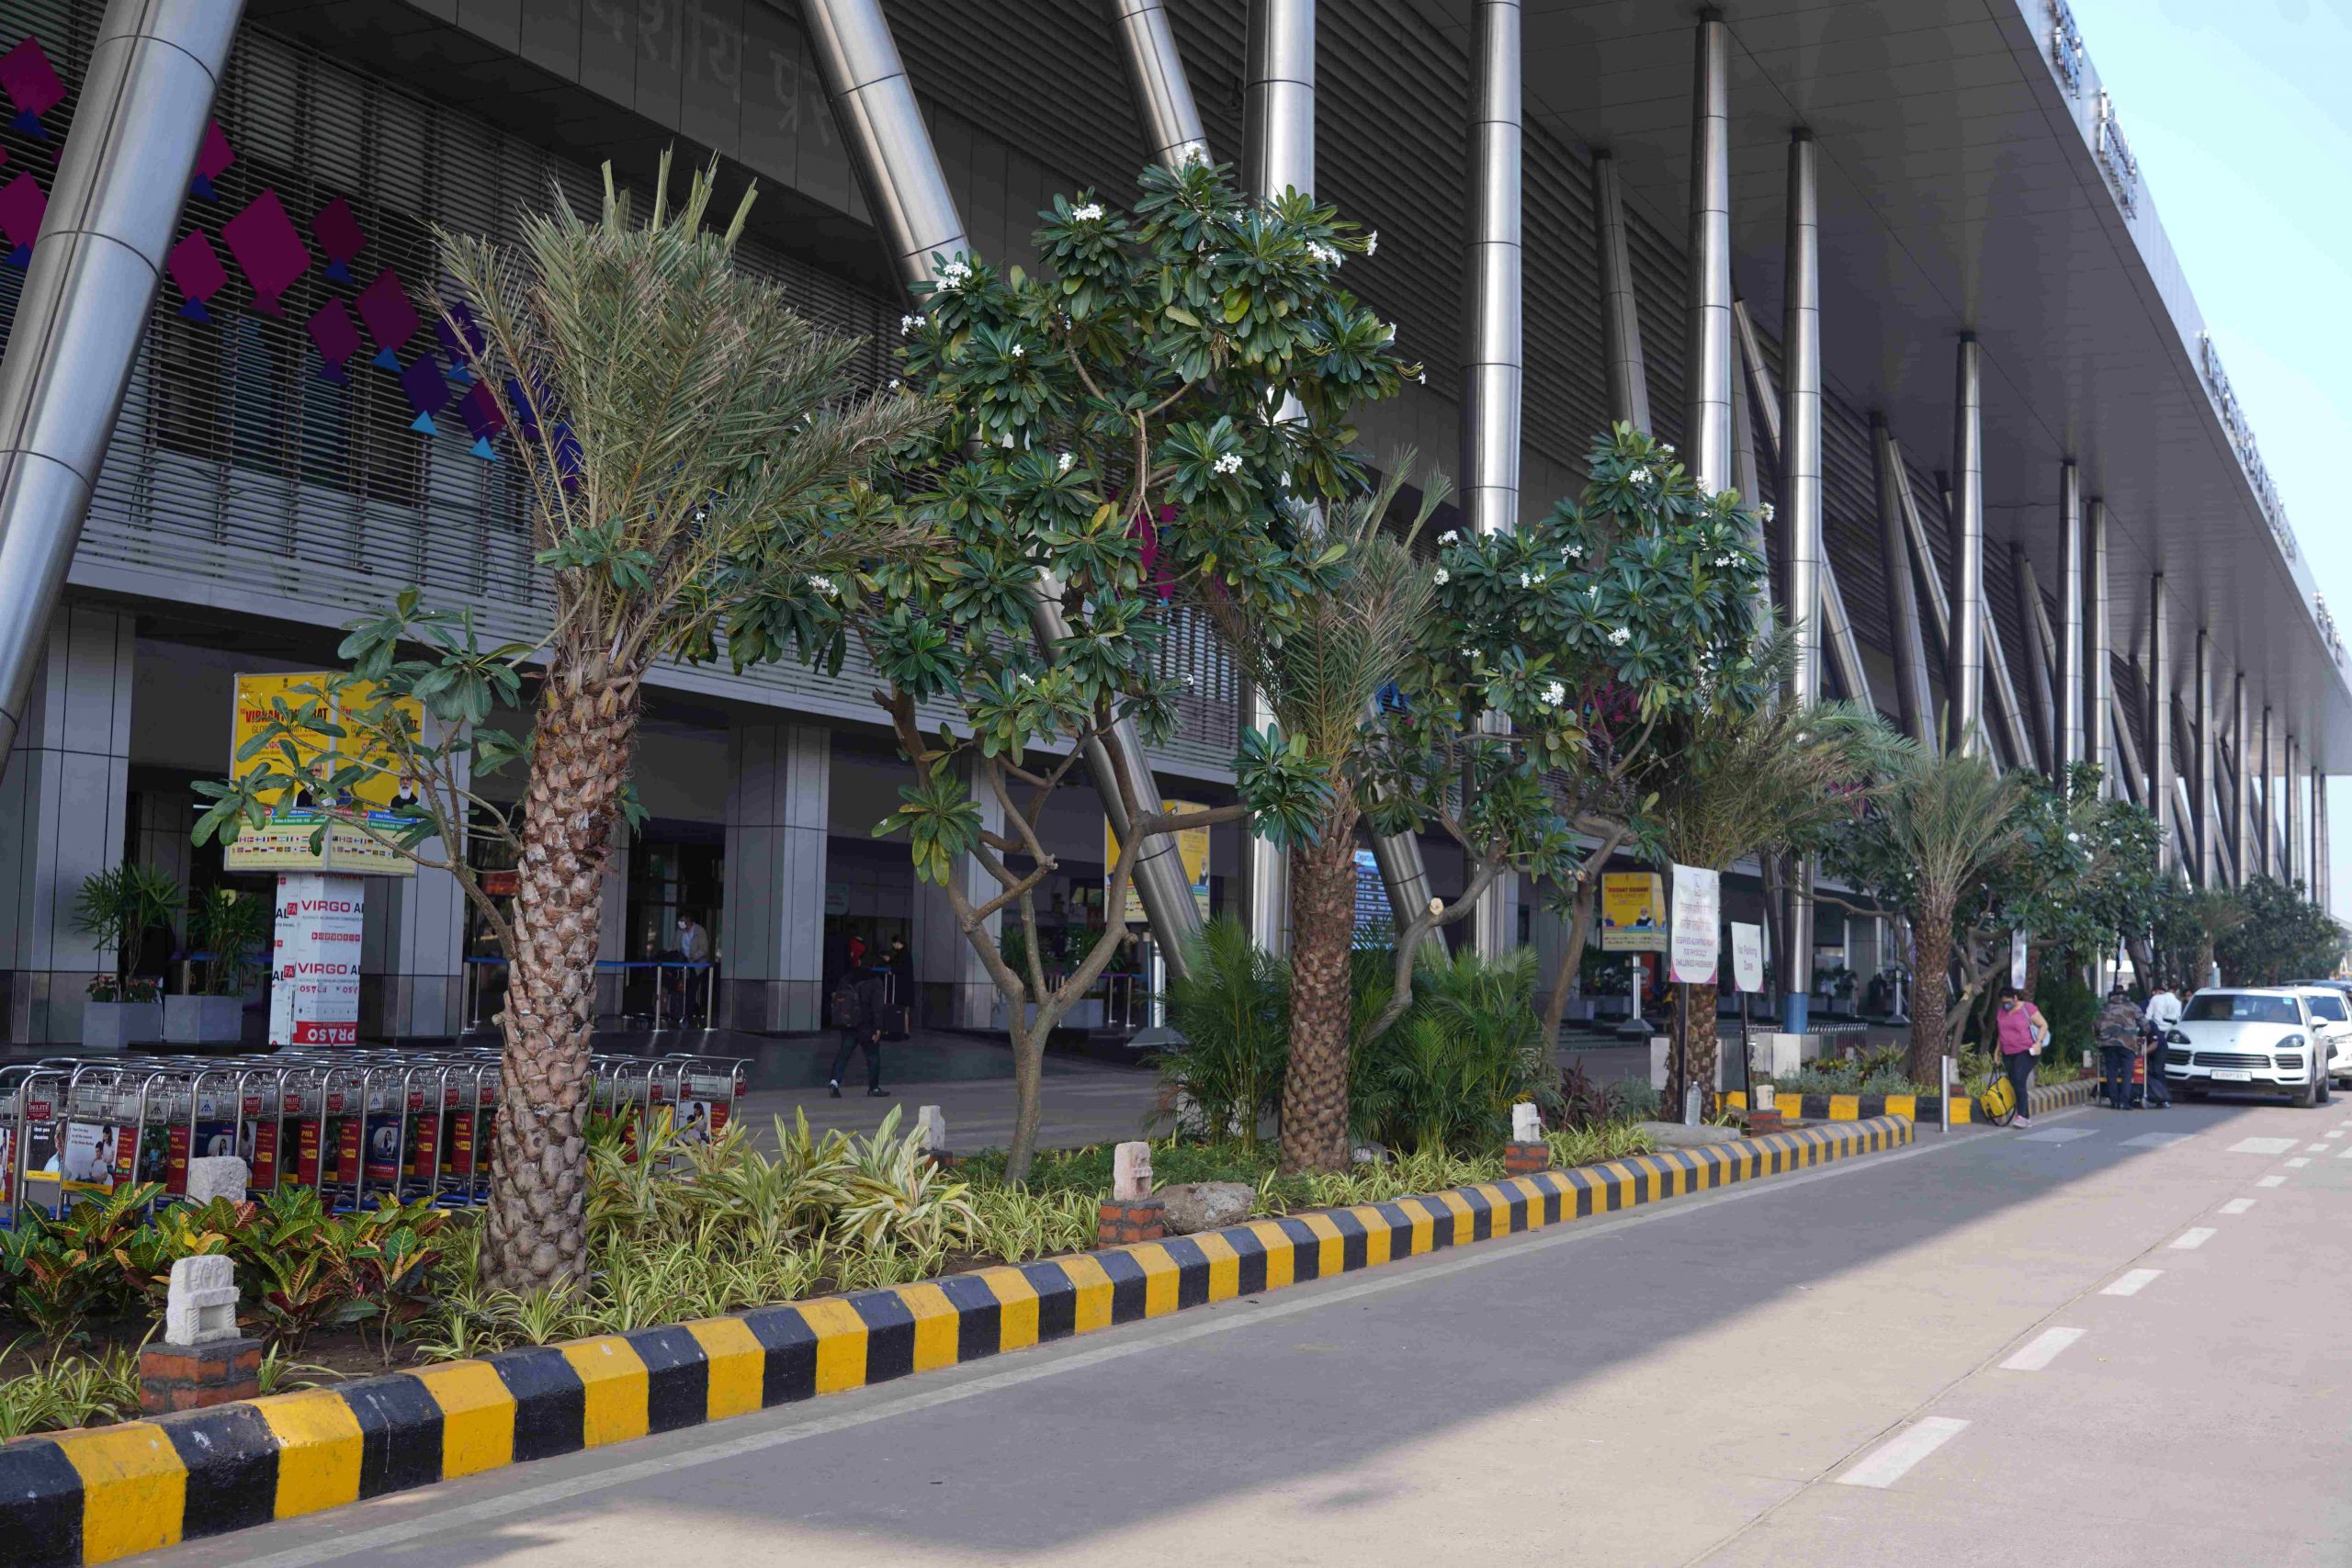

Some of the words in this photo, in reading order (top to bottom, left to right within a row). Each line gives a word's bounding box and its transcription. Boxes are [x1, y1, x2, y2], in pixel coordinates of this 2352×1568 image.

[300, 899, 351, 913] VIRGO
[1744, 944, 1758, 958] Parking
[298, 962, 347, 975] VIRGO
[1744, 961, 1753, 971] Zone
[307, 1028, 356, 1045] PRASO
[301, 1130, 313, 1138] PNB
